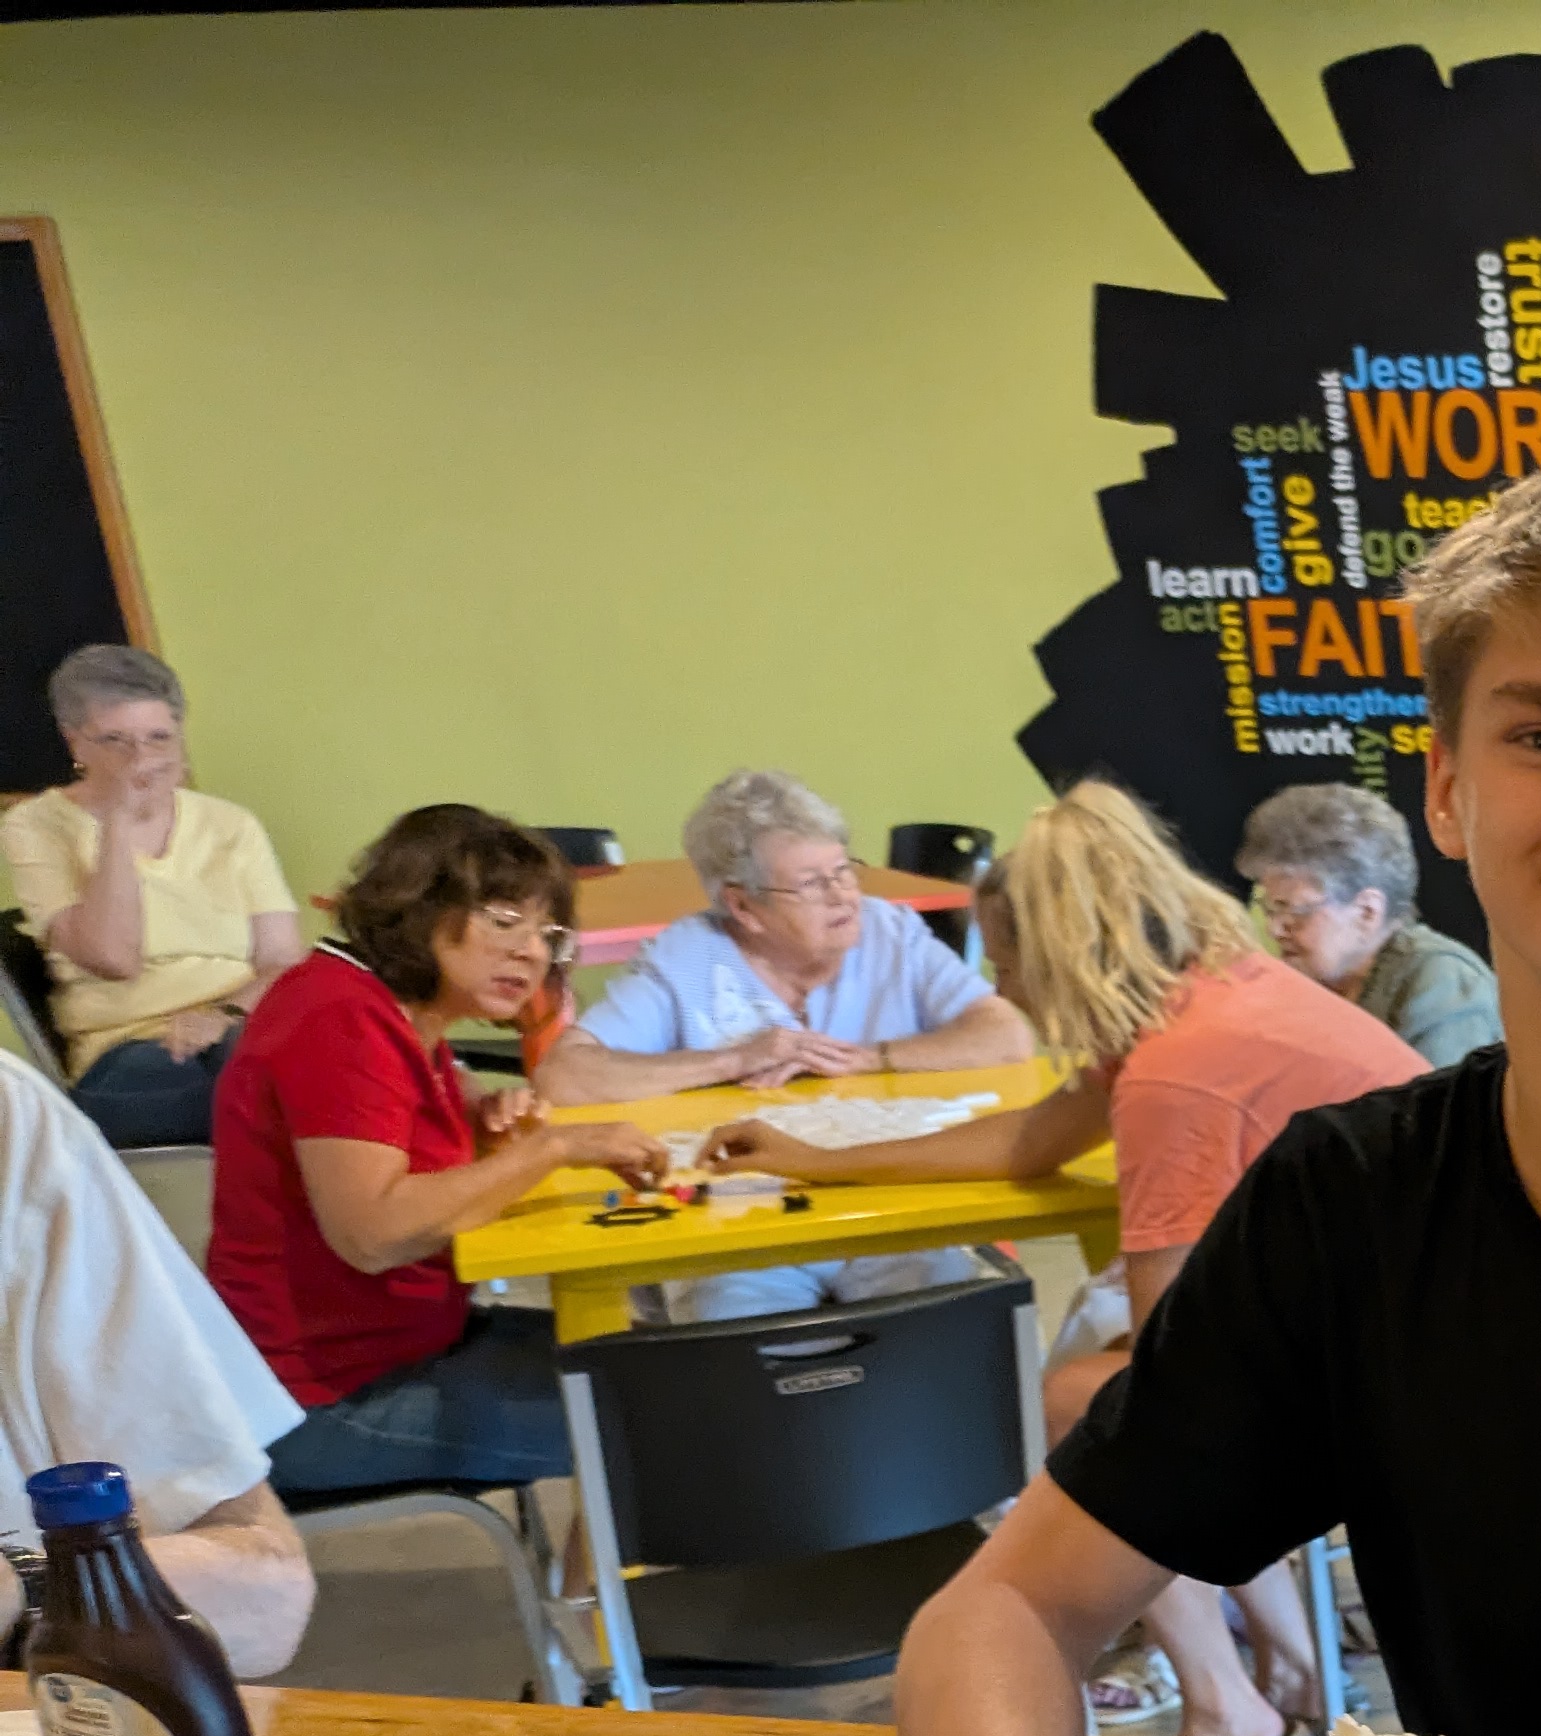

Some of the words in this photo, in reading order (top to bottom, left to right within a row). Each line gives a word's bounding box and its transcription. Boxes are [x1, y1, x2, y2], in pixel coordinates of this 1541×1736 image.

[1475, 251, 1515, 388] restore
[1343, 345, 1487, 390] Jesus
[1231, 416, 1325, 453] seek
[1317, 369, 1349, 442] weak
[1329, 447, 1357, 491] the
[1239, 456, 1288, 594] comfort
[1281, 473, 1335, 588] give
[1337, 496, 1368, 590] defend
[1145, 556, 1262, 599] learn
[1215, 601, 1261, 753] mission
[1265, 721, 1356, 756] work
